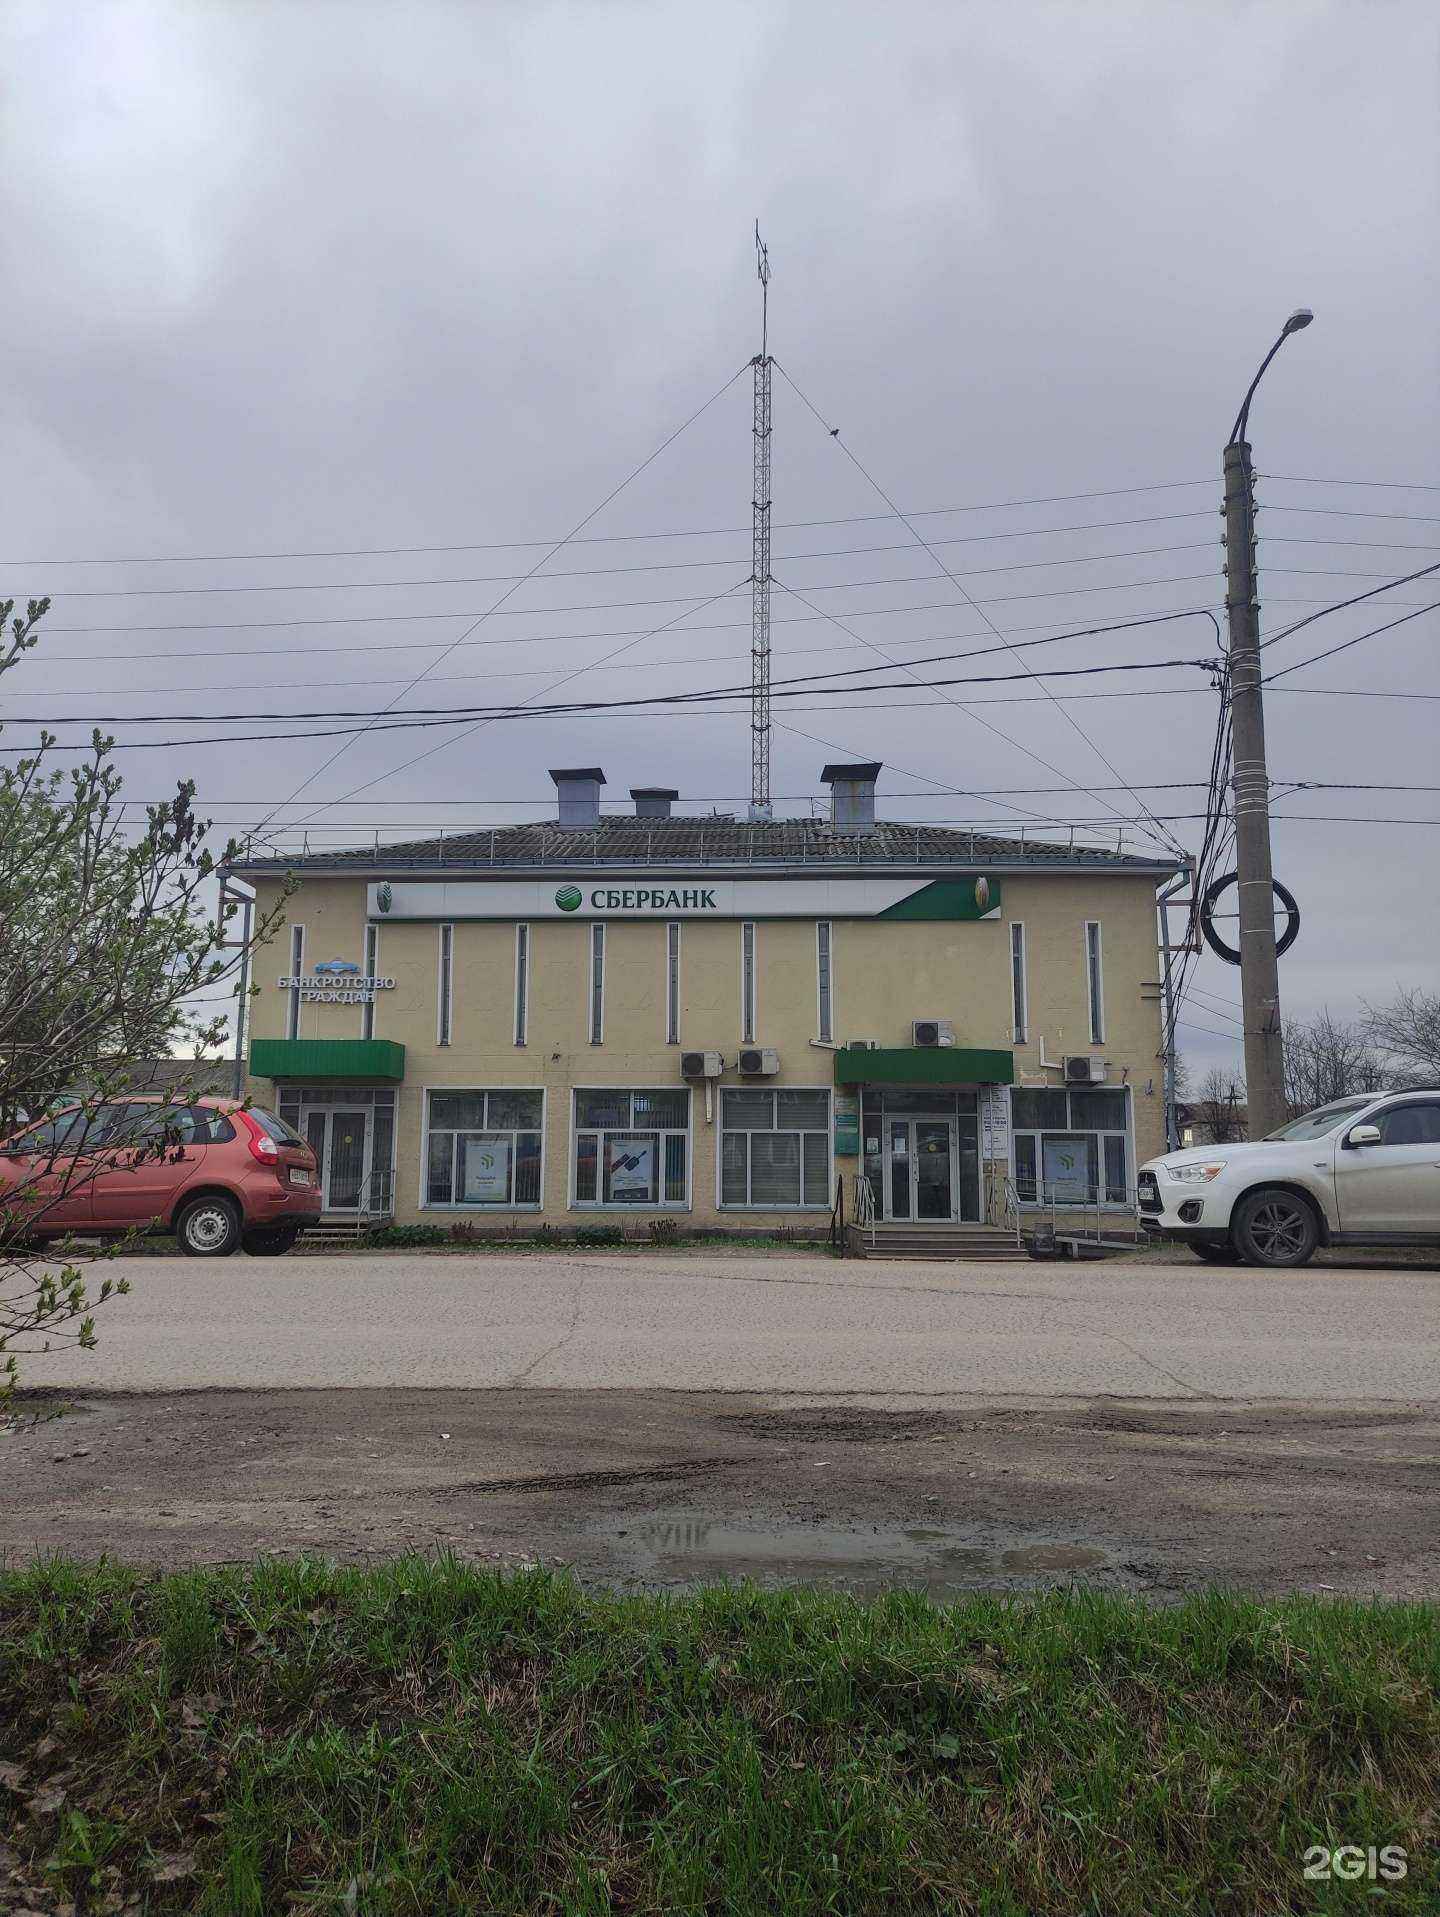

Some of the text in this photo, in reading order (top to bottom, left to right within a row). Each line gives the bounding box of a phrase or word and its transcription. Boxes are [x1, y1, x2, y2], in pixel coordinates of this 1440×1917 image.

[590, 889, 717, 909] СБЕРБАНК
[278, 976, 396, 989] БАНКРОТСТВО
[299, 990, 376, 1004] ГРАЖДАН
